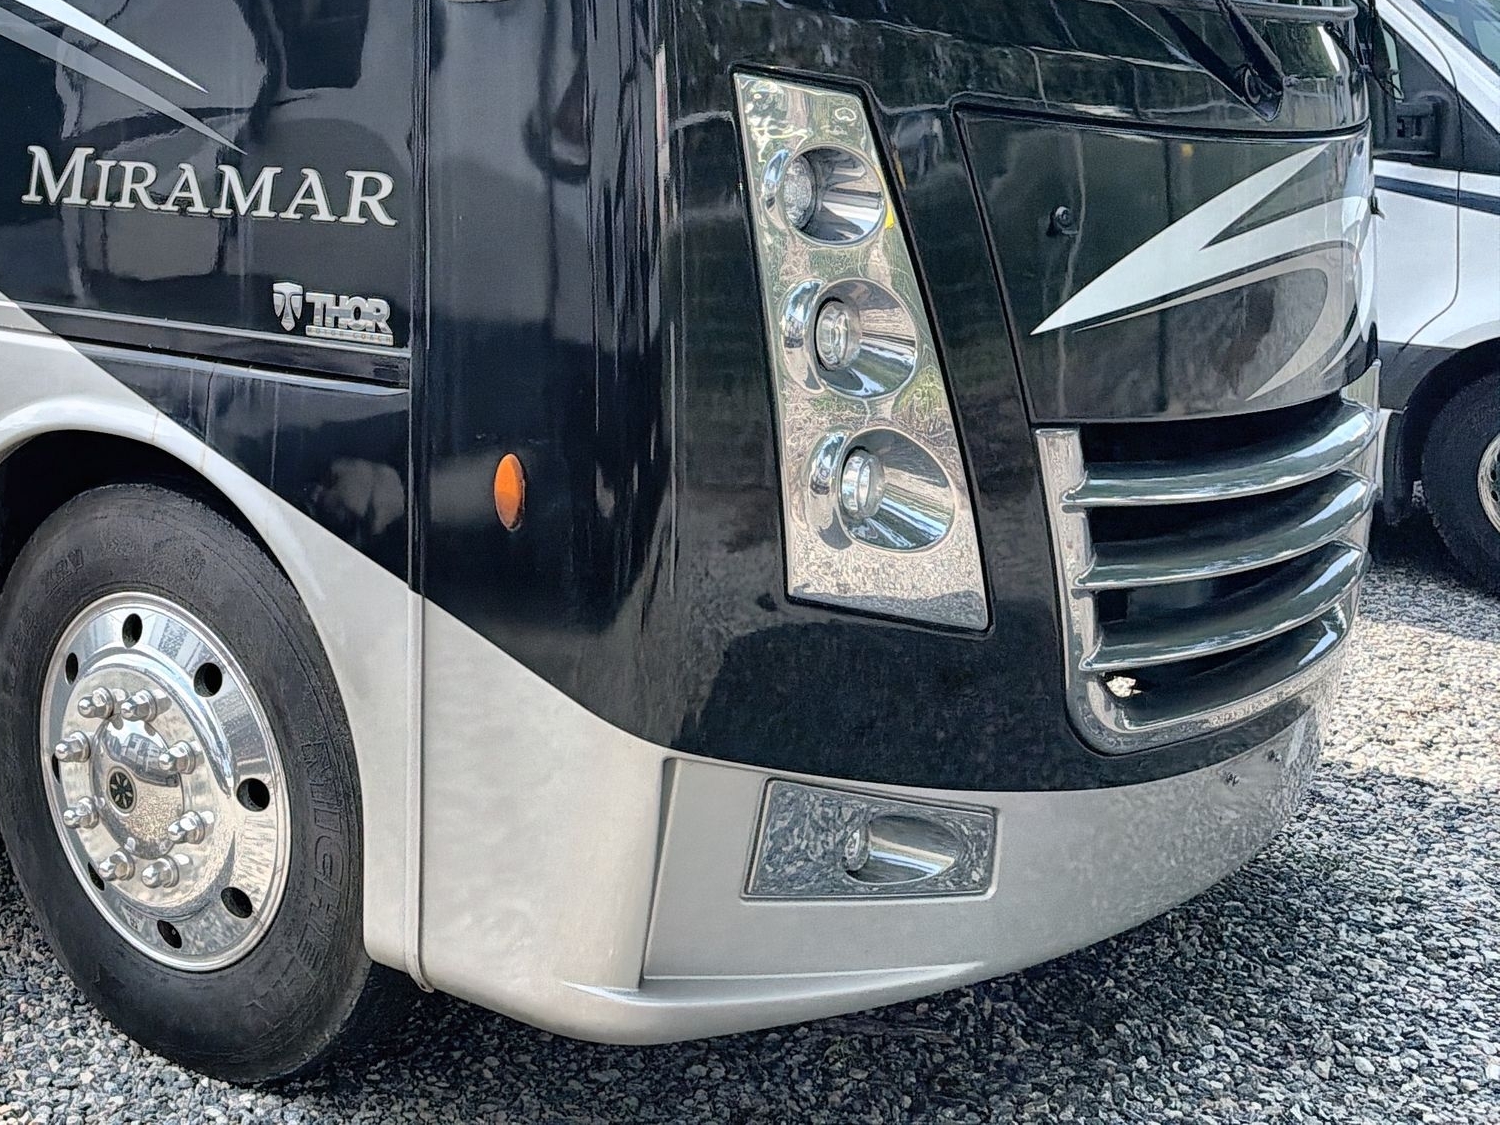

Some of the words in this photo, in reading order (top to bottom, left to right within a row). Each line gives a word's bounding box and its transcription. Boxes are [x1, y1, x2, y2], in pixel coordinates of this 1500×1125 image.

[20, 145, 398, 227] MIRAMAR
[305, 292, 393, 334] THOR
[306, 326, 344, 338] MOTOR
[352, 331, 393, 343] COACH
